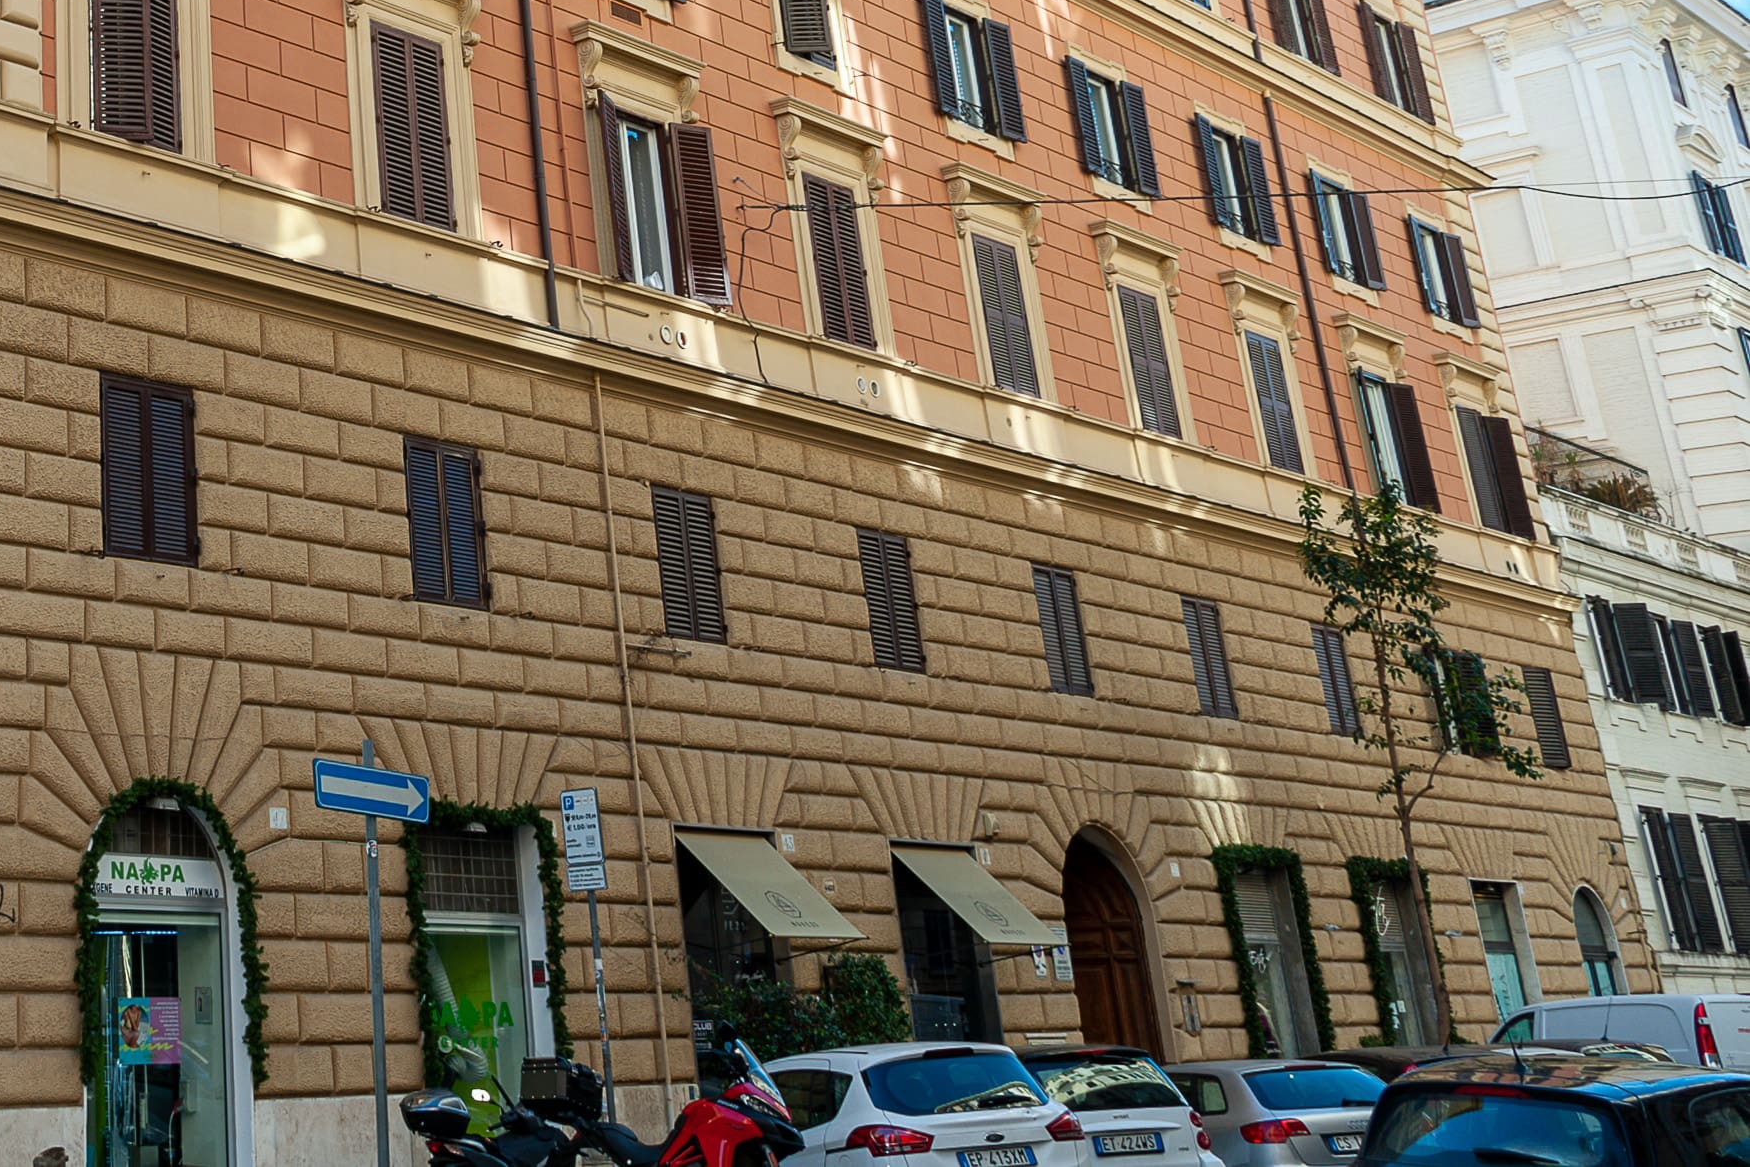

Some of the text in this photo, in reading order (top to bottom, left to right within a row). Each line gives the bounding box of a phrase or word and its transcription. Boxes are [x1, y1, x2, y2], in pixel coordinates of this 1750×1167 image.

[125, 885, 172, 895] CENTER
[1101, 1135, 1156, 1152] ET 424WS
[967, 1153, 983, 1167] EP
